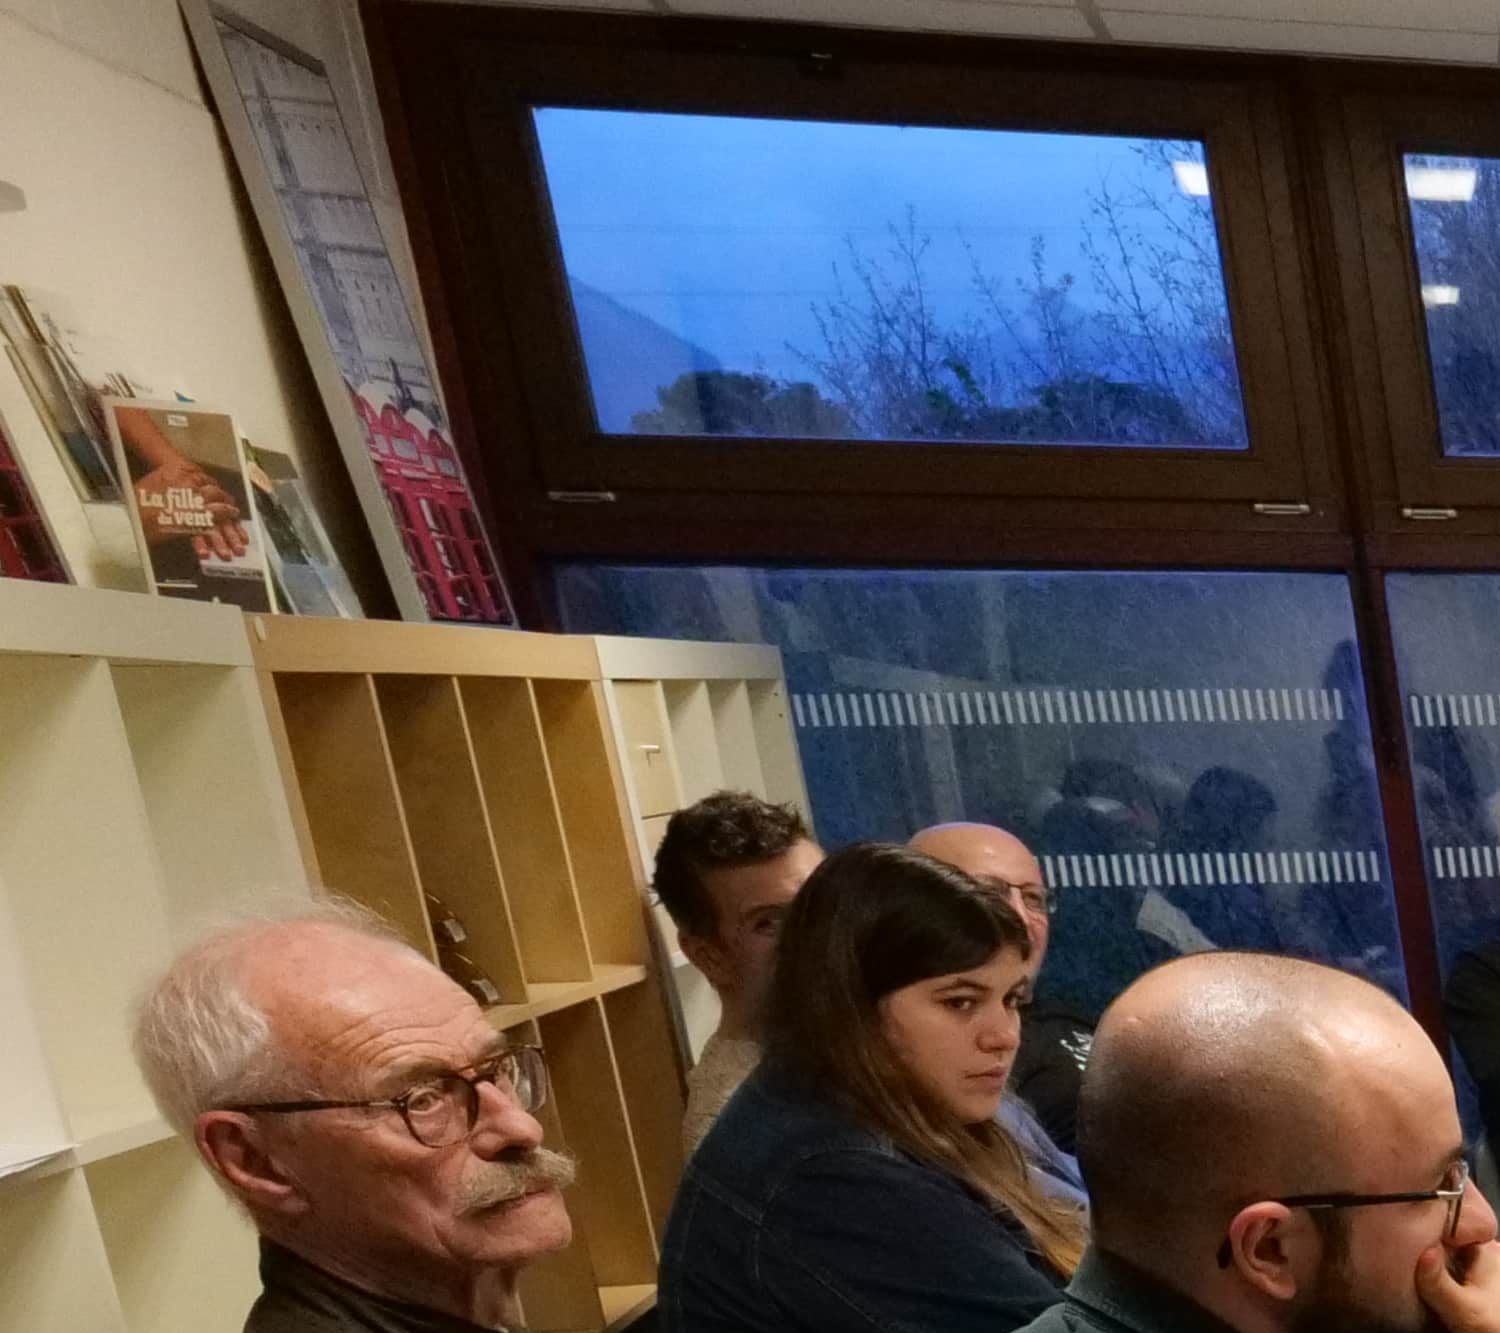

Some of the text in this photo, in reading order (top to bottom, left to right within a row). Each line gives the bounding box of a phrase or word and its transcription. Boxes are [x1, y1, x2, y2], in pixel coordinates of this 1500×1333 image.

[139, 487, 205, 514] La fille
[173, 510, 214, 528] vent
